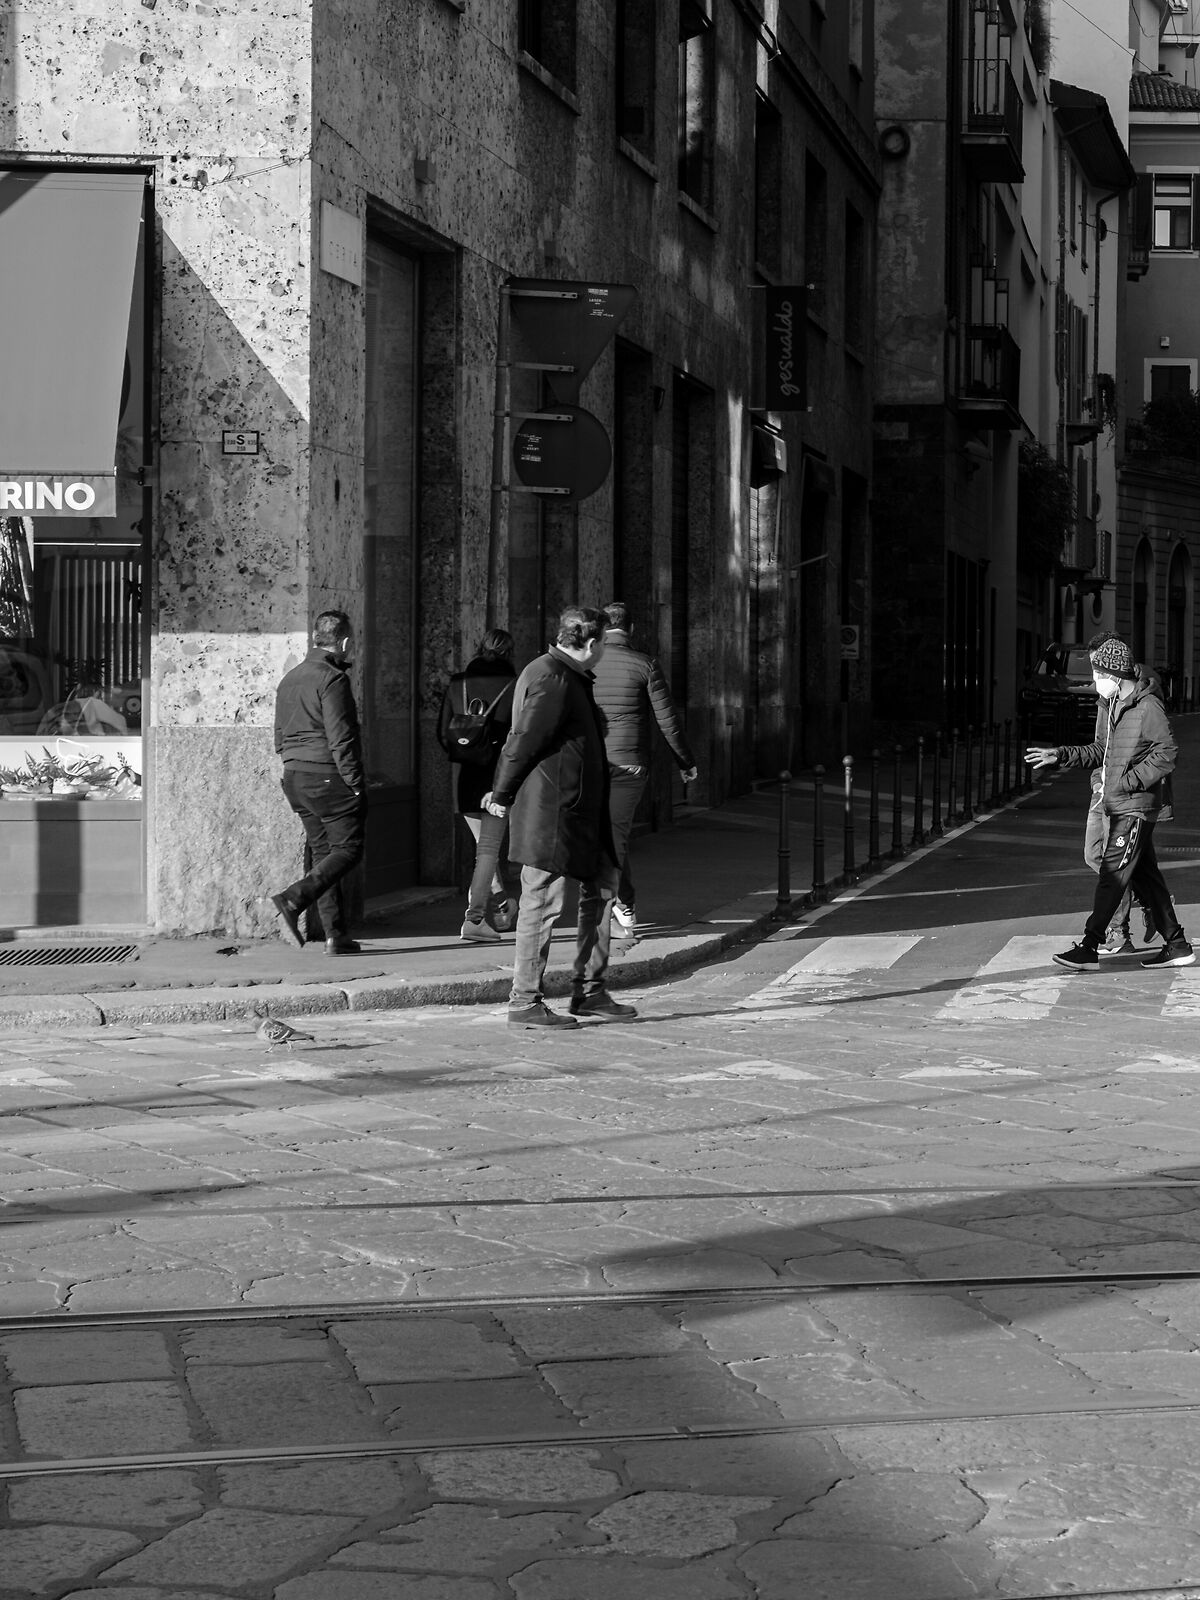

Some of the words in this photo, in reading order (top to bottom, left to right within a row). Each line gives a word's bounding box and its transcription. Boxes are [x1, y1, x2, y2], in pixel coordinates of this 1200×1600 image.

[772, 300, 800, 396] gesualdo
[236, 434, 245, 445] S
[0, 481, 95, 511] RINO
